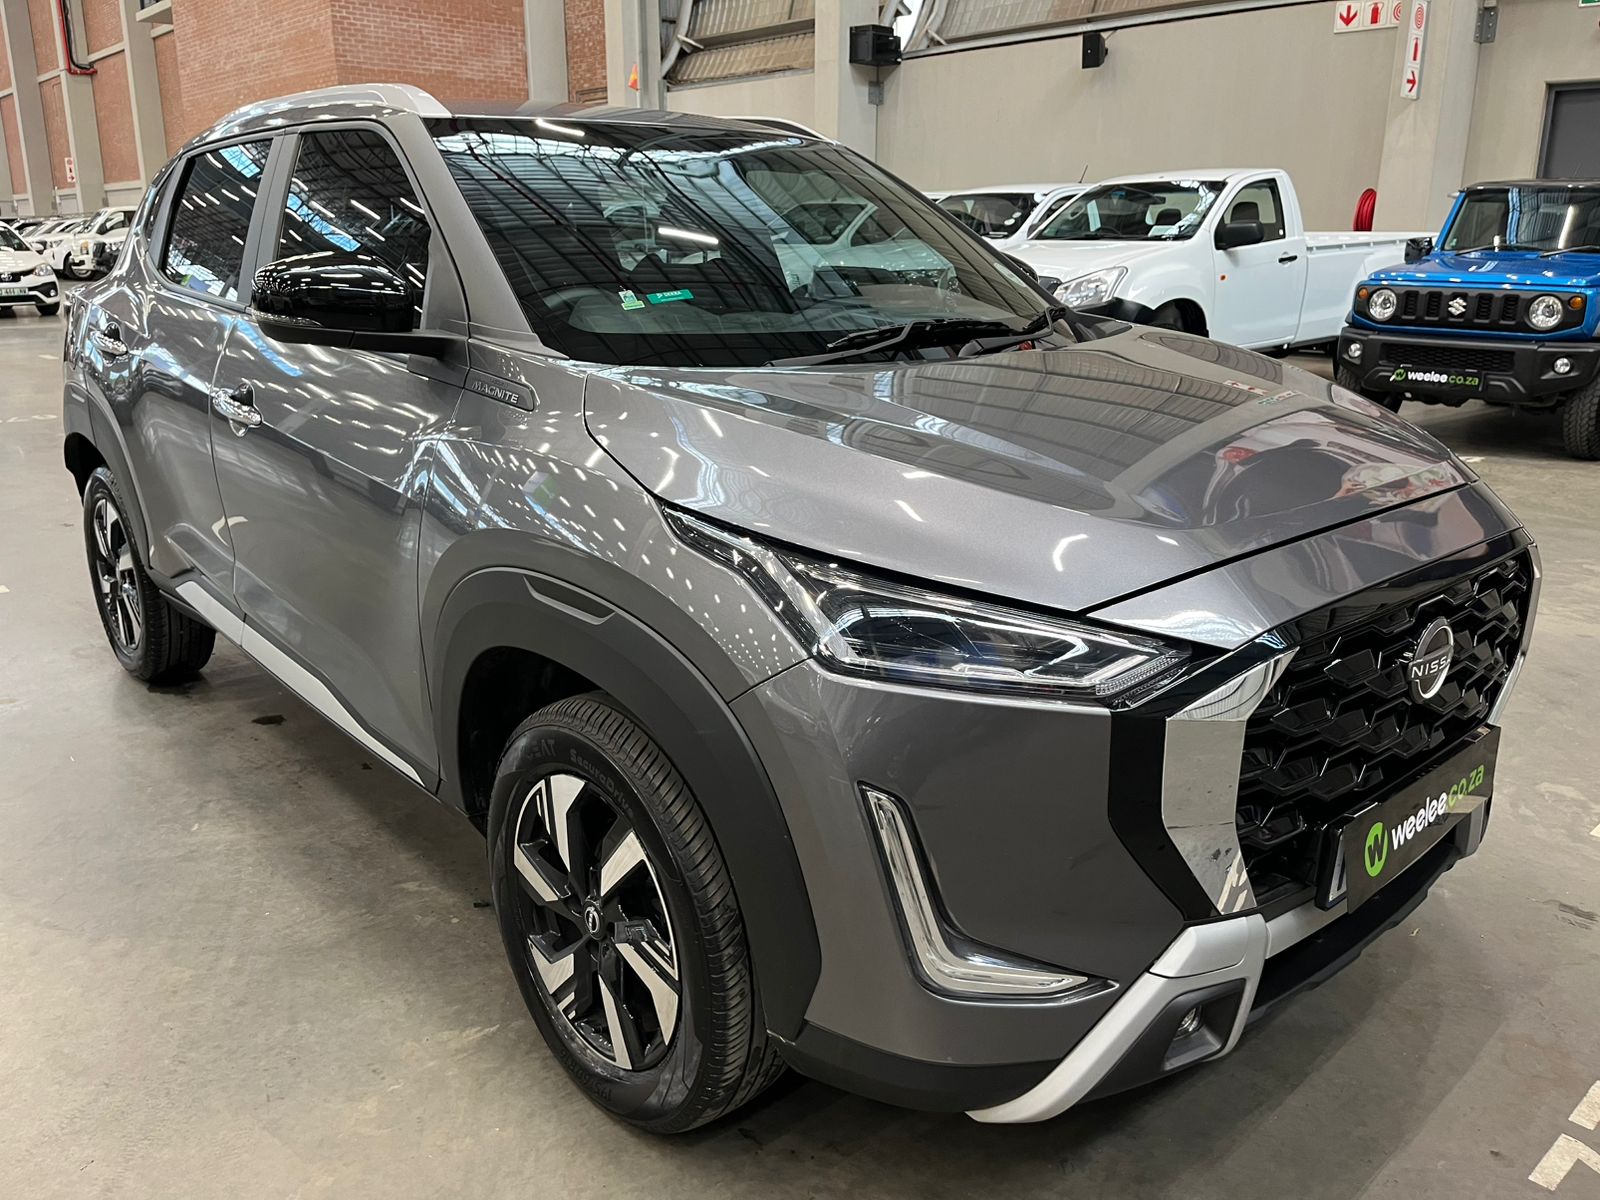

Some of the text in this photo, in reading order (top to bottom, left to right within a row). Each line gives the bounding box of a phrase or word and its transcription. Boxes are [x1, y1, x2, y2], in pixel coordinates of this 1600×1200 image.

[471, 381, 519, 403] MAGNITE
[1411, 655, 1448, 678] NISS
[527, 739, 557, 759] EAT
